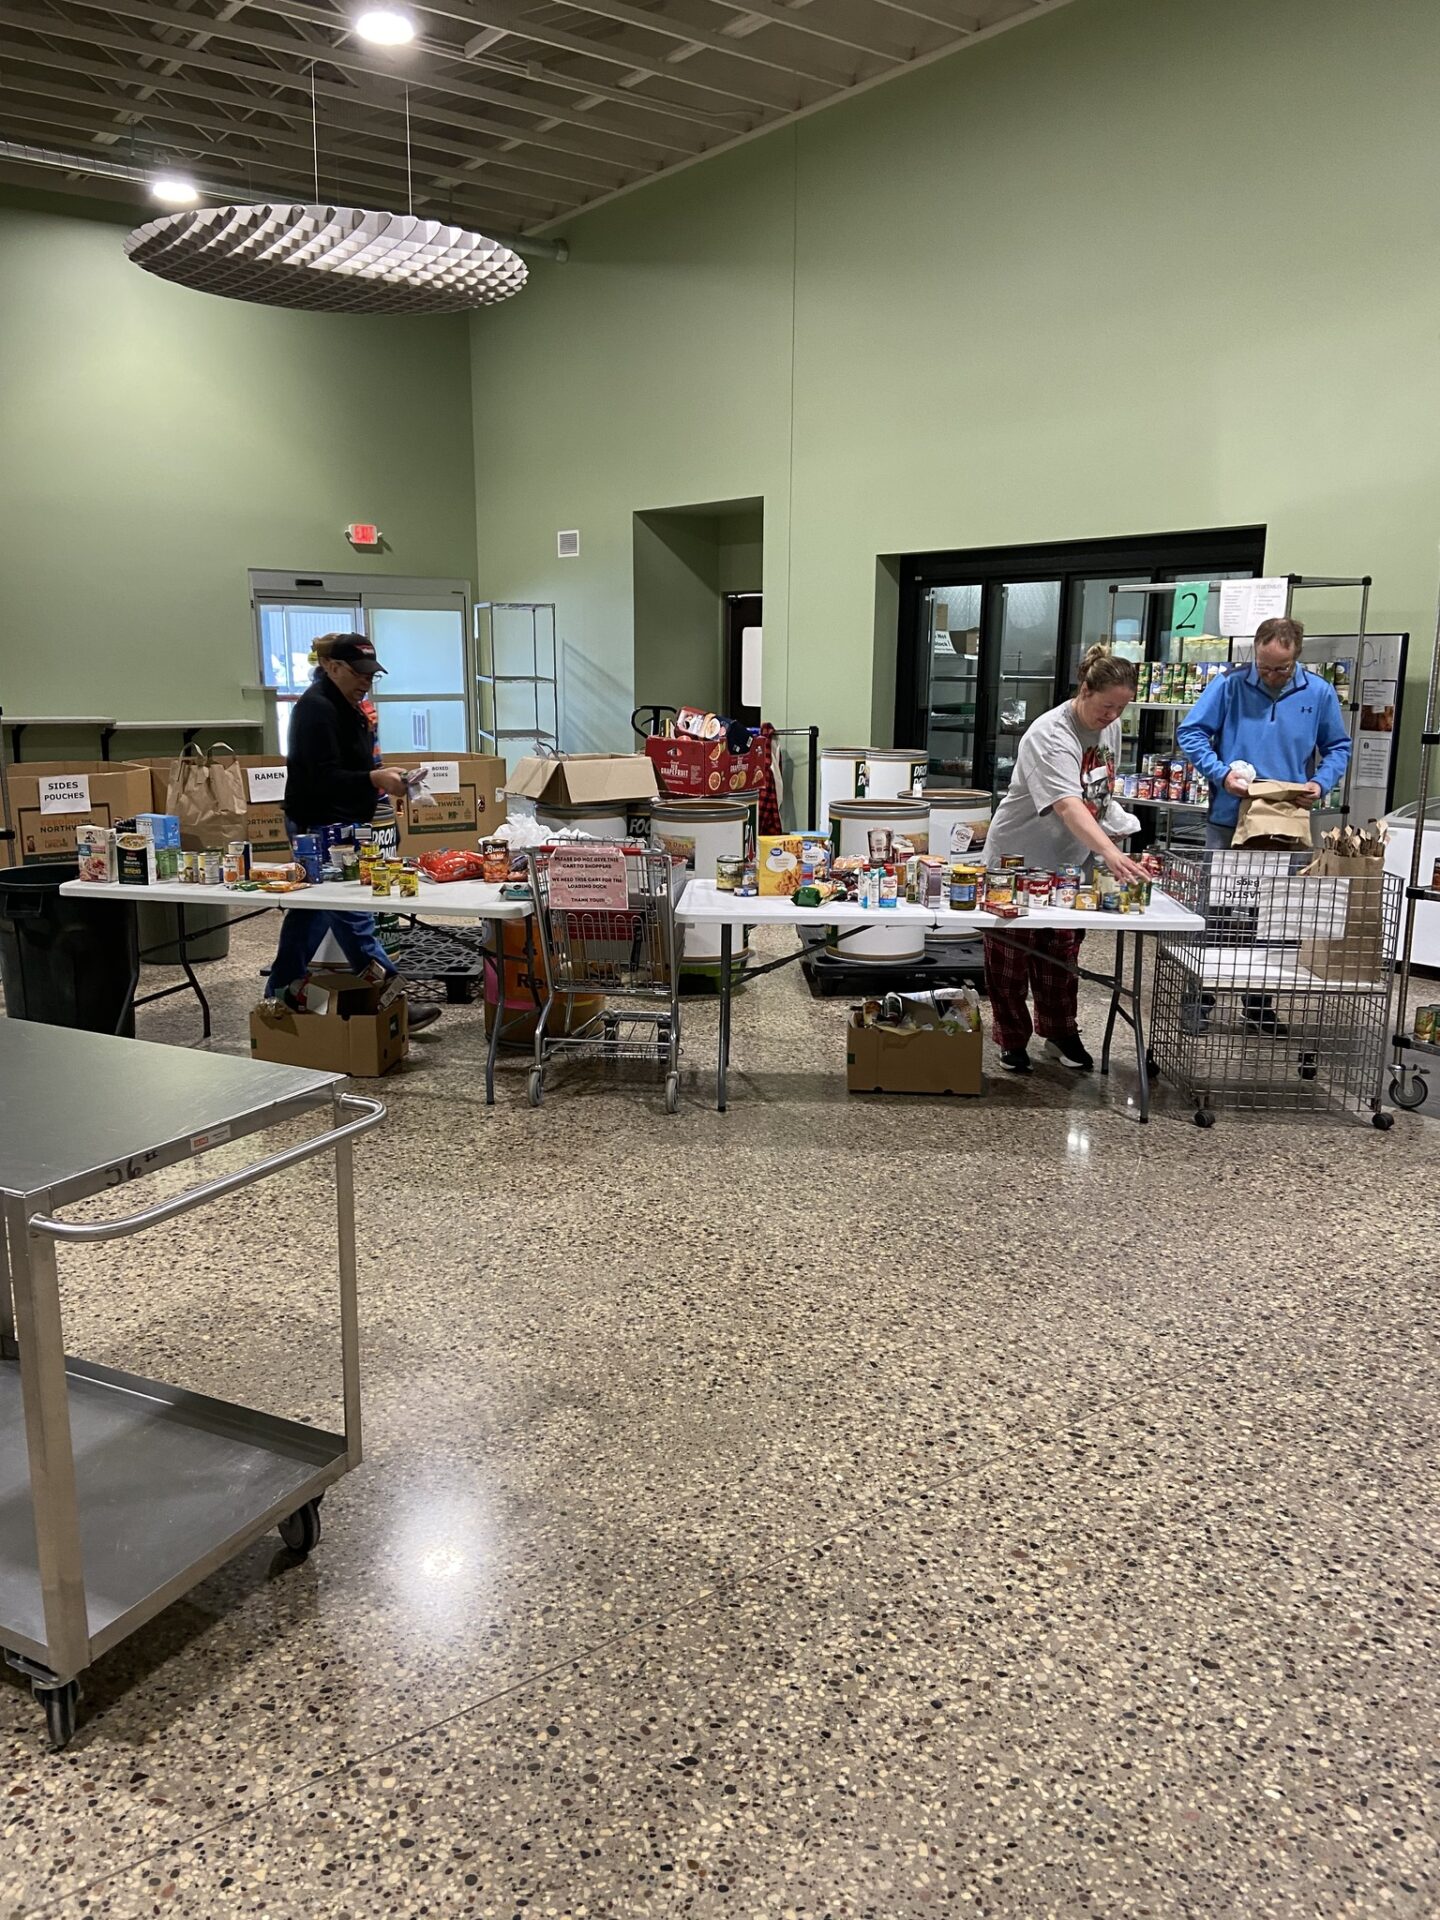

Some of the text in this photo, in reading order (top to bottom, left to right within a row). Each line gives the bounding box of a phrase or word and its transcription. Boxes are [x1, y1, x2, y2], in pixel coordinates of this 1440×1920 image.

[1175, 592, 1198, 630] 2
[255, 772, 285, 780] RAMEN
[48, 782, 79, 790] SIDES
[44, 792, 85, 801] POUCHES
